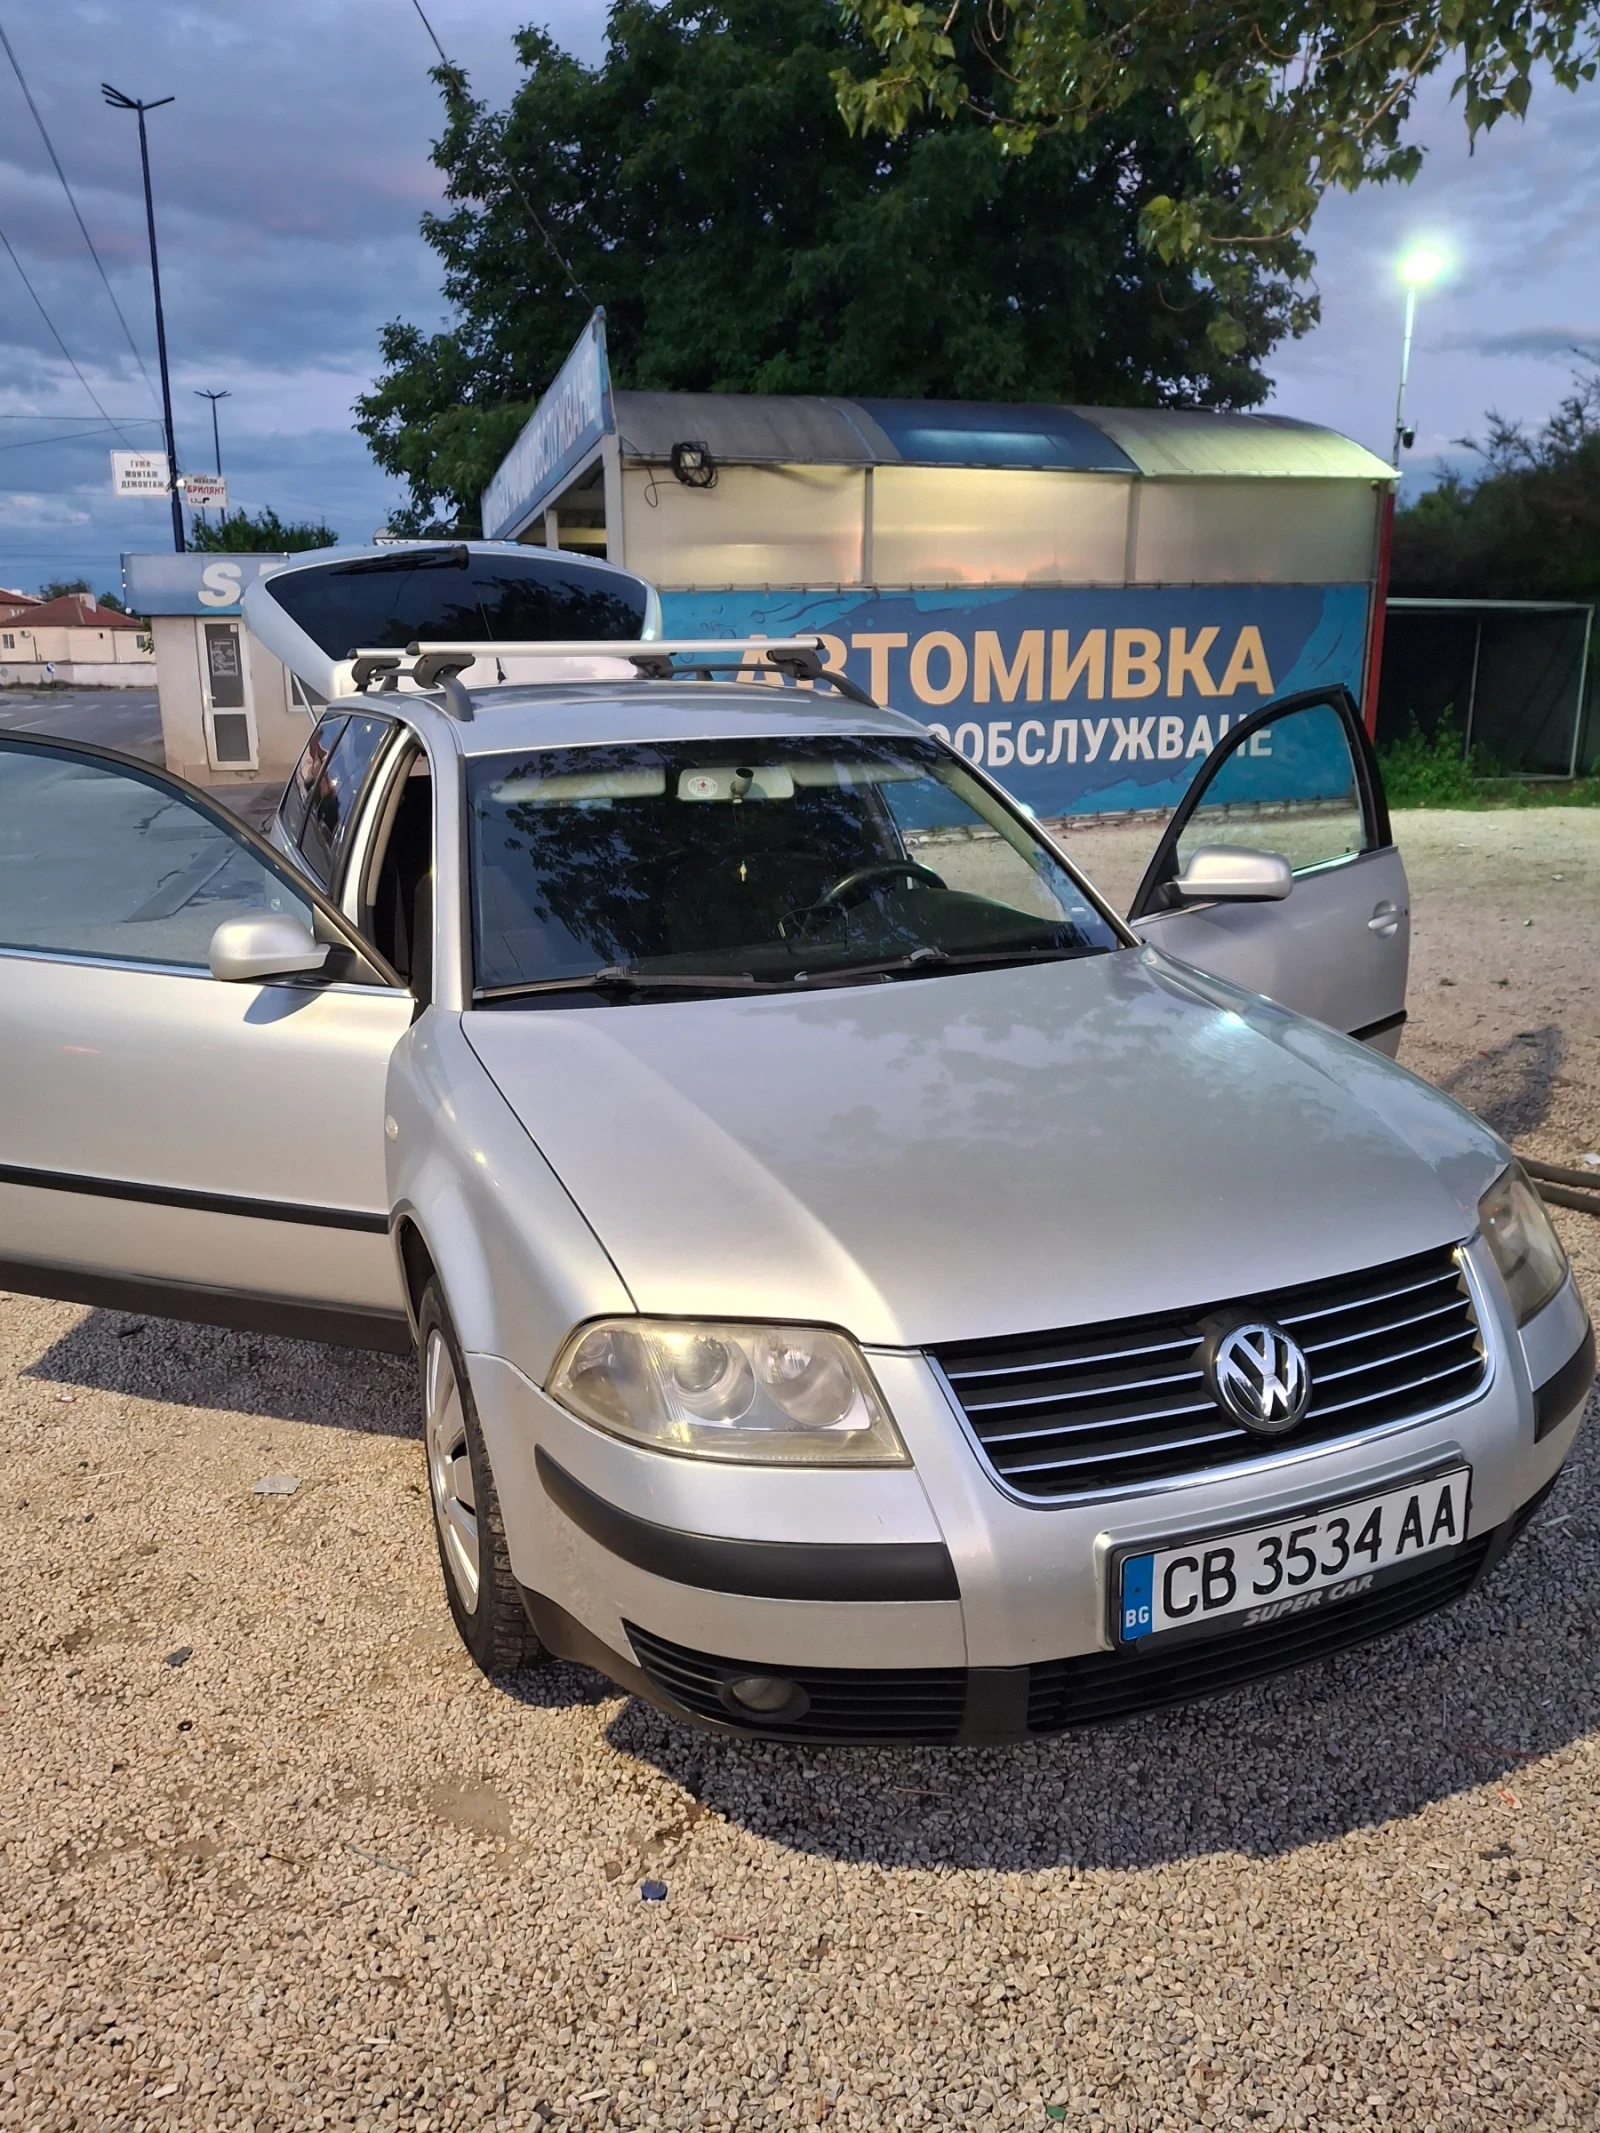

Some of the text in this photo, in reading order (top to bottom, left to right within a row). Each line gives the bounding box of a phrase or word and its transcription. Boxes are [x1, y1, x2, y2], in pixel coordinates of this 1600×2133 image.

[125, 470, 158, 478] МОНТАЖ
[121, 480, 165, 488] ДЕМОНТАЖ
[186, 485, 225, 495] БРИЛЯНТ
[1163, 1485, 1457, 1618] CB 3534 AA
[1243, 1574, 1373, 1626] SUPER CAR
[1125, 1605, 1150, 1628] BG
